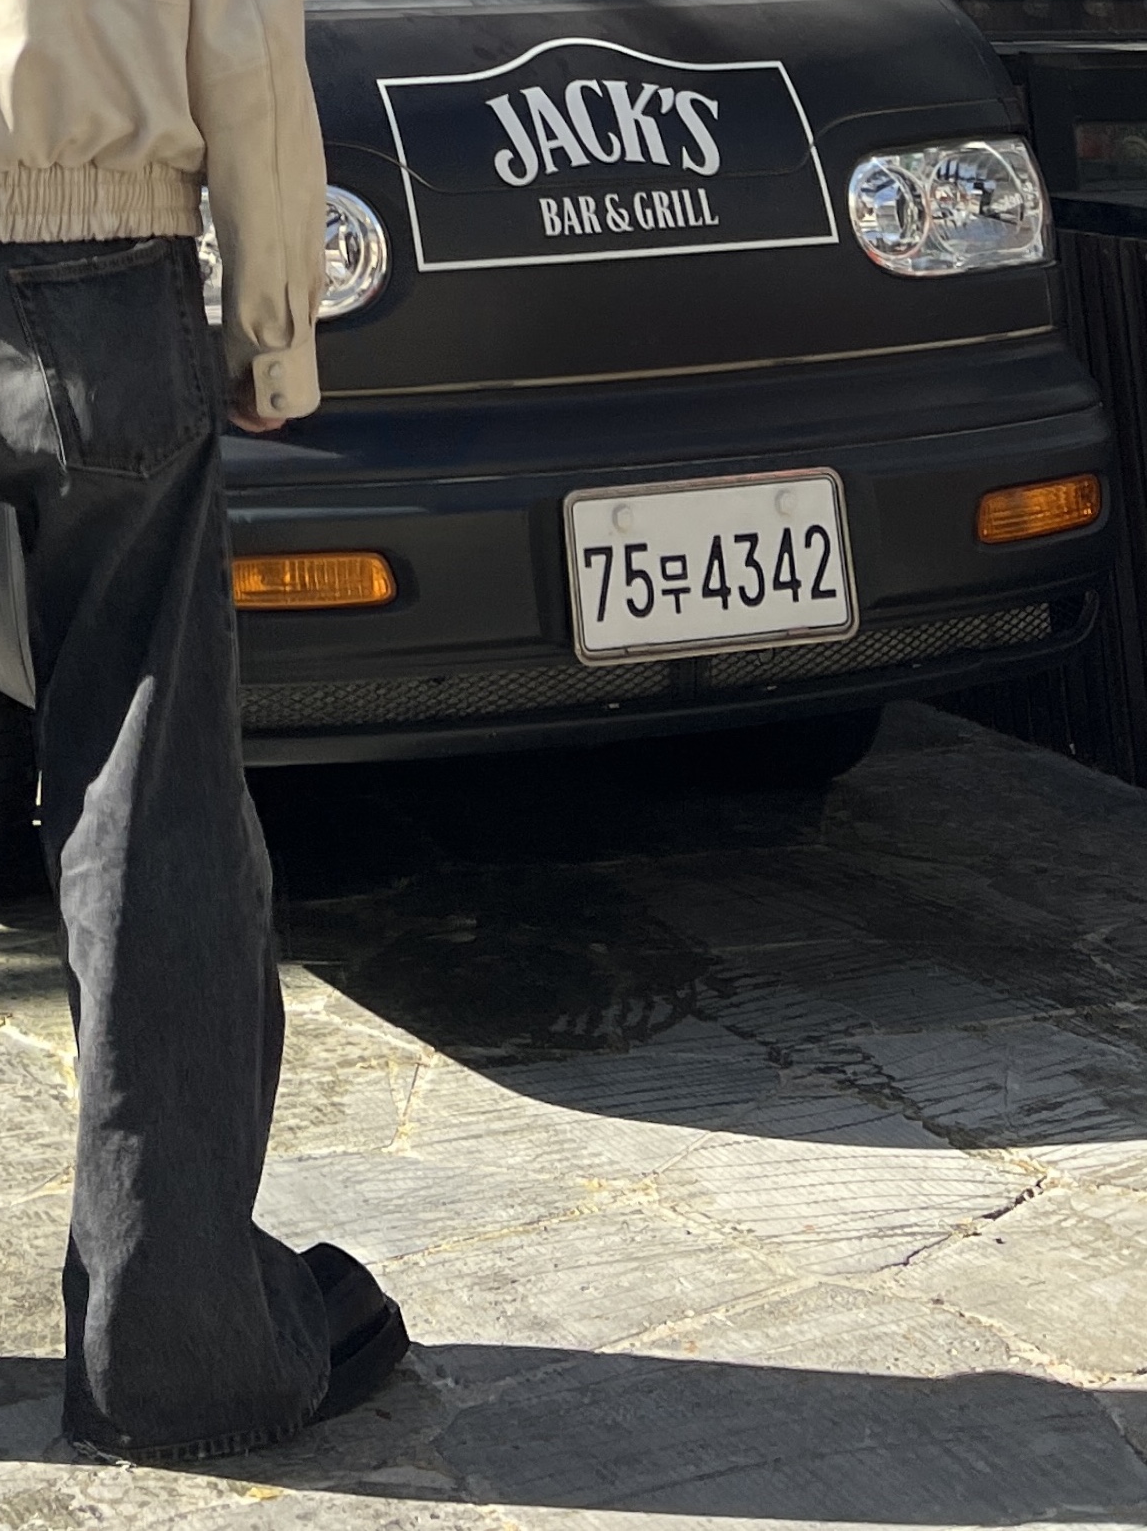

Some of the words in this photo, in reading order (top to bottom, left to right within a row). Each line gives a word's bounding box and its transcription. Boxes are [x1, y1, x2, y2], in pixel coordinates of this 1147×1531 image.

[485, 78, 720, 187] JACK'S
[539, 197, 602, 237] BAR
[605, 193, 634, 233] &
[634, 187, 720, 231] GRILL
[583, 524, 838, 623] 75무4342
